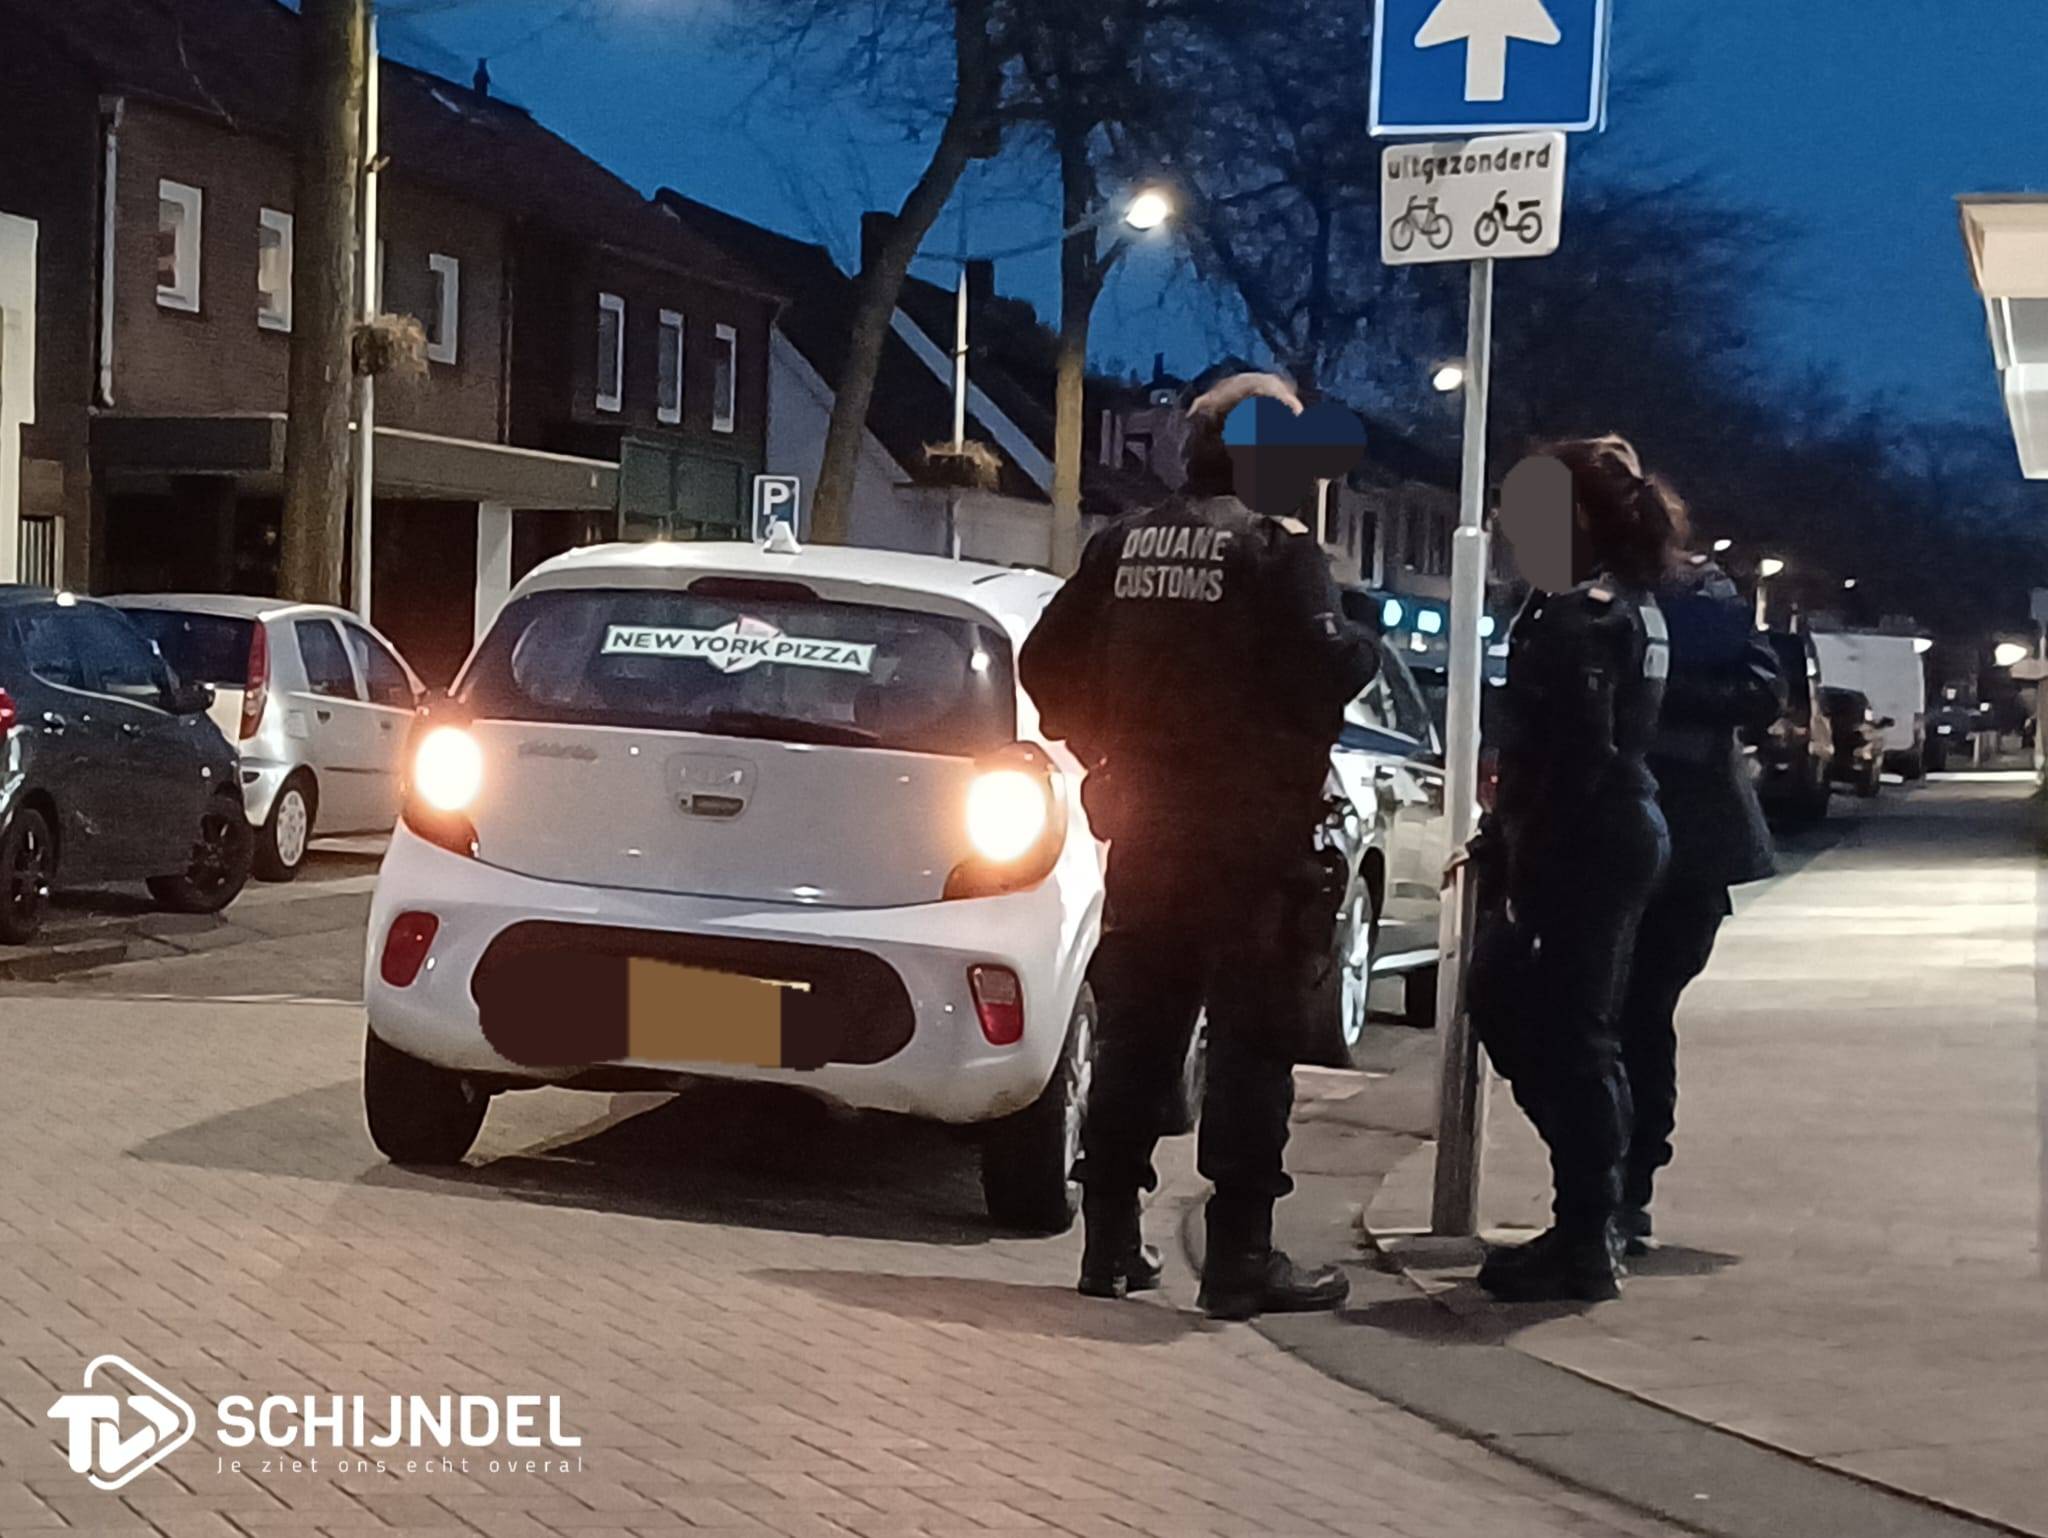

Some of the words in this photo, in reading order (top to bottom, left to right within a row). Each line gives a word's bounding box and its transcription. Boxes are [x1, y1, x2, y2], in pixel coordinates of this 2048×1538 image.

[1387, 142, 1552, 185] uitgezonderd
[763, 481, 791, 515] P
[1121, 525, 1234, 562] DOUANE
[1113, 564, 1225, 602] CUSTOMS
[612, 631, 684, 650] NEW
[691, 634, 768, 657] YORK
[774, 641, 863, 667] PIZZA
